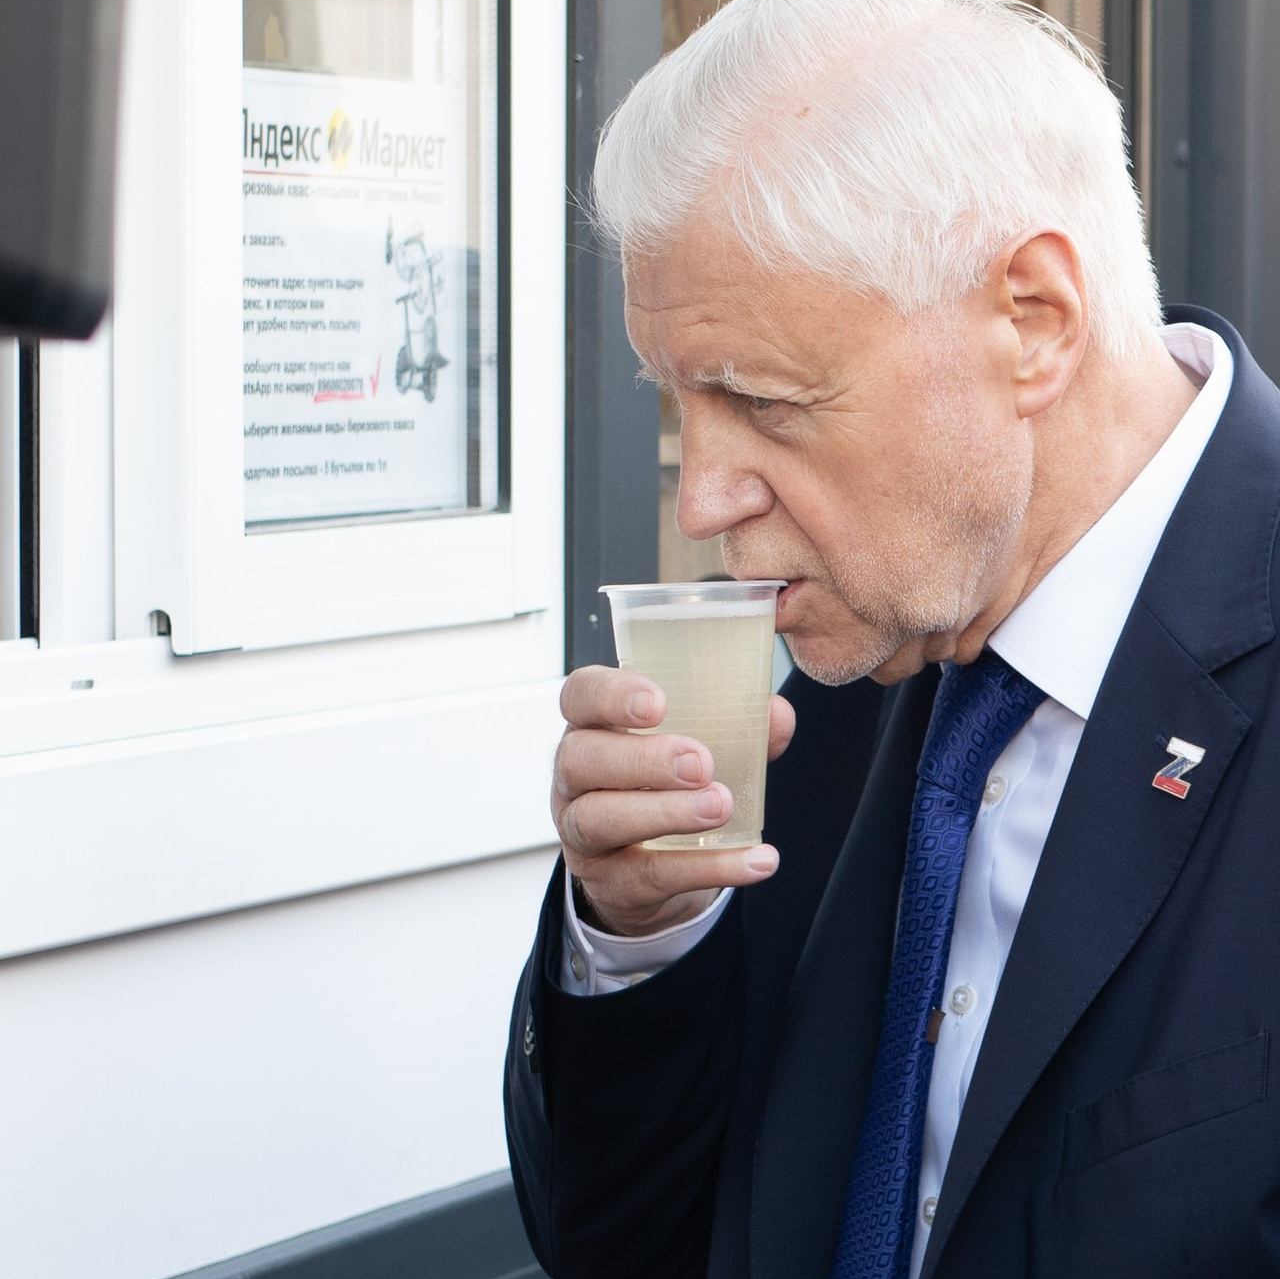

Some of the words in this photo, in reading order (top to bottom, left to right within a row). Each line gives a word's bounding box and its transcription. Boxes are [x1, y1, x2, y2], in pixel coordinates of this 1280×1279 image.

[359, 119, 446, 177] Маркет
[287, 184, 310, 198] квас
[282, 278, 306, 291] адрес
[308, 279, 333, 293] пункта
[267, 299, 271, 309] в
[274, 299, 307, 313] котором
[310, 300, 325, 310] вам
[257, 315, 287, 334] удобно
[290, 320, 326, 334] получить
[329, 320, 361, 333] посылку
[283, 361, 306, 375] адрес
[309, 361, 334, 375] пункта
[274, 383, 283, 393] по
[286, 382, 315, 396] номеру
[281, 423, 322, 436] желаемые
[325, 423, 345, 434] виды
[348, 419, 391, 435] березового
[393, 419, 415, 431] кваса
[283, 463, 317, 477] посылка
[331, 461, 363, 478] бутылок
[366, 461, 376, 471] по
